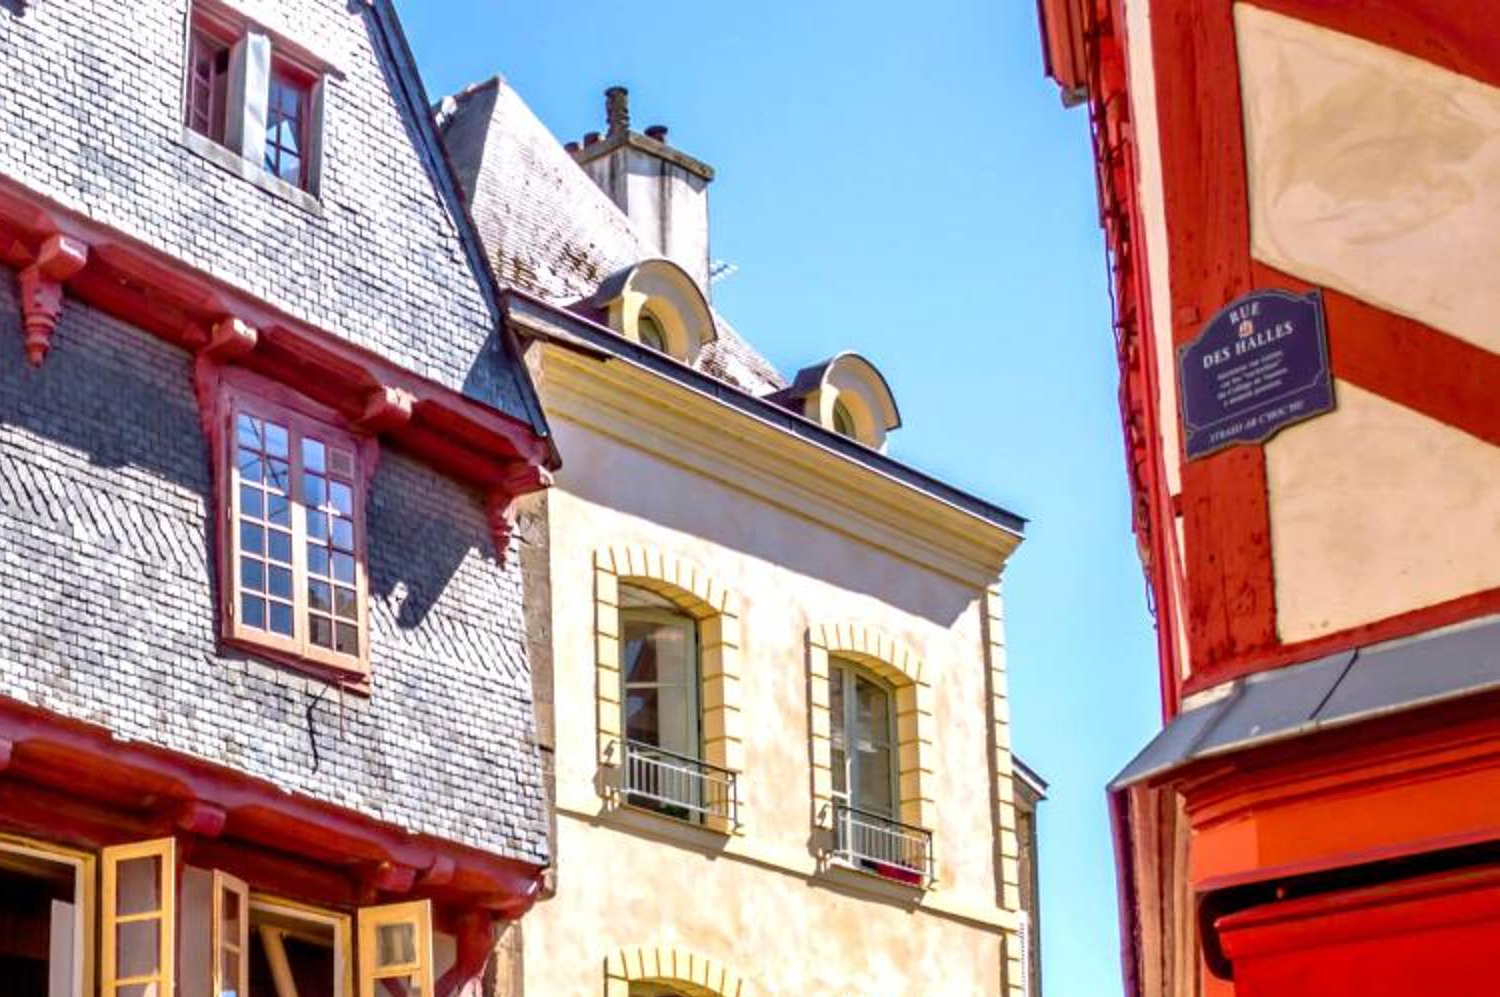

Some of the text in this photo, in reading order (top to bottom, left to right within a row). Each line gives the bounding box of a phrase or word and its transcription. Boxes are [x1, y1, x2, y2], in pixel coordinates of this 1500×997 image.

[1229, 301, 1261, 325] RUE
[1203, 320, 1294, 369] DES HALLES
